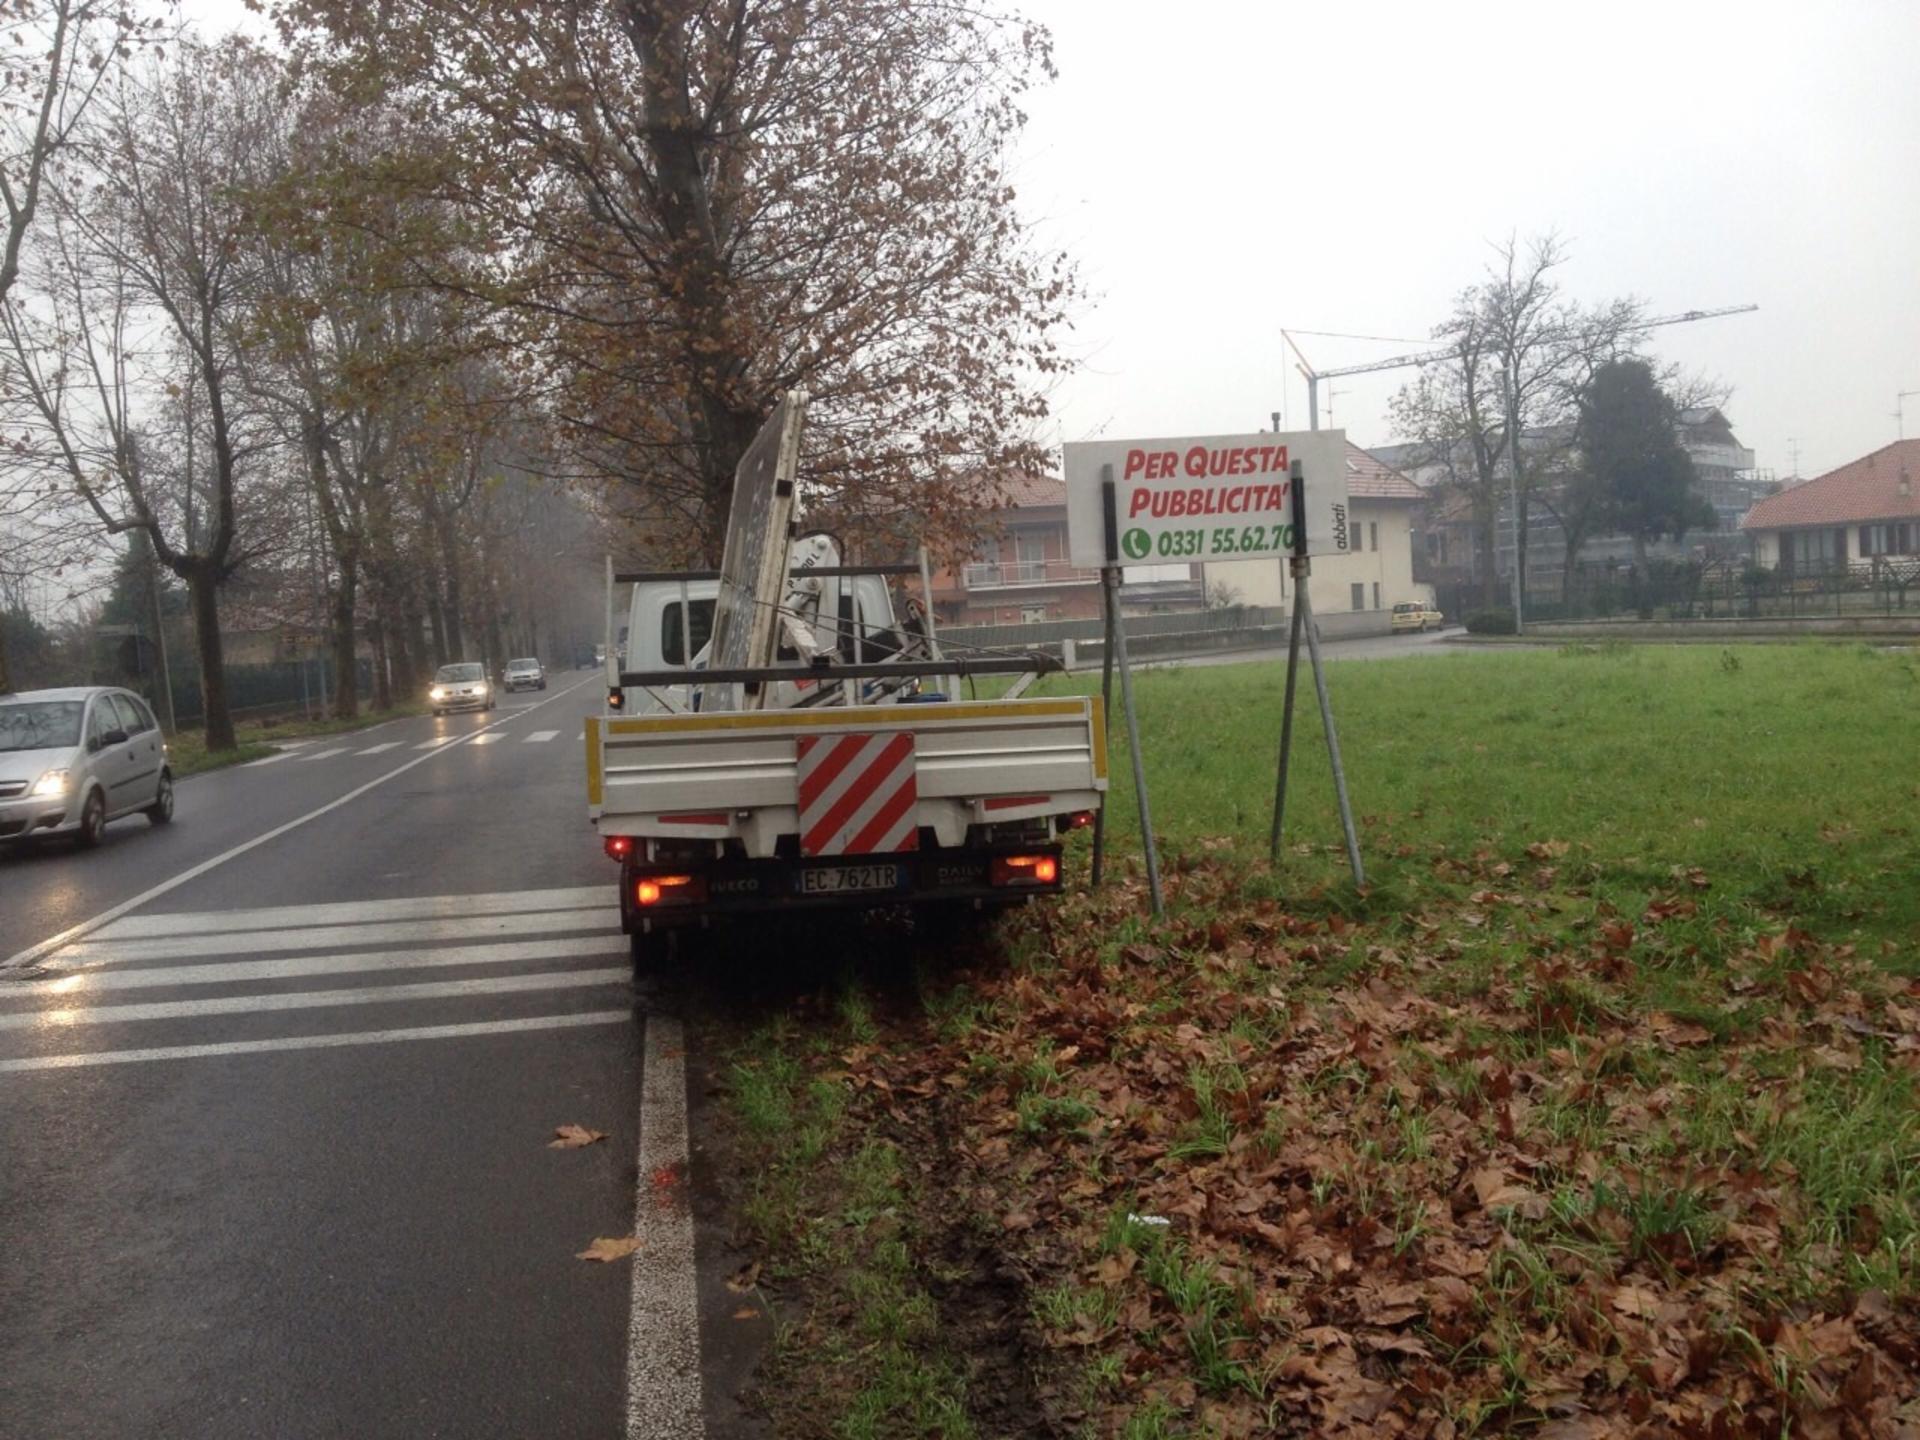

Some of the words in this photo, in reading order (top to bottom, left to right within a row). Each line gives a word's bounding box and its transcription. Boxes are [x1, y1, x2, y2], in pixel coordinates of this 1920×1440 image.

[1124, 449, 1178, 480] PER
[1184, 446, 1288, 478] QUESTA
[1129, 483, 1289, 518] PUBBLICITA'
[1158, 529, 1205, 556] 0331
[1211, 525, 1296, 553] 55.62.70
[1331, 503, 1347, 550] abbiati
[804, 871, 827, 890] EC
[836, 867, 895, 888] 762TR
